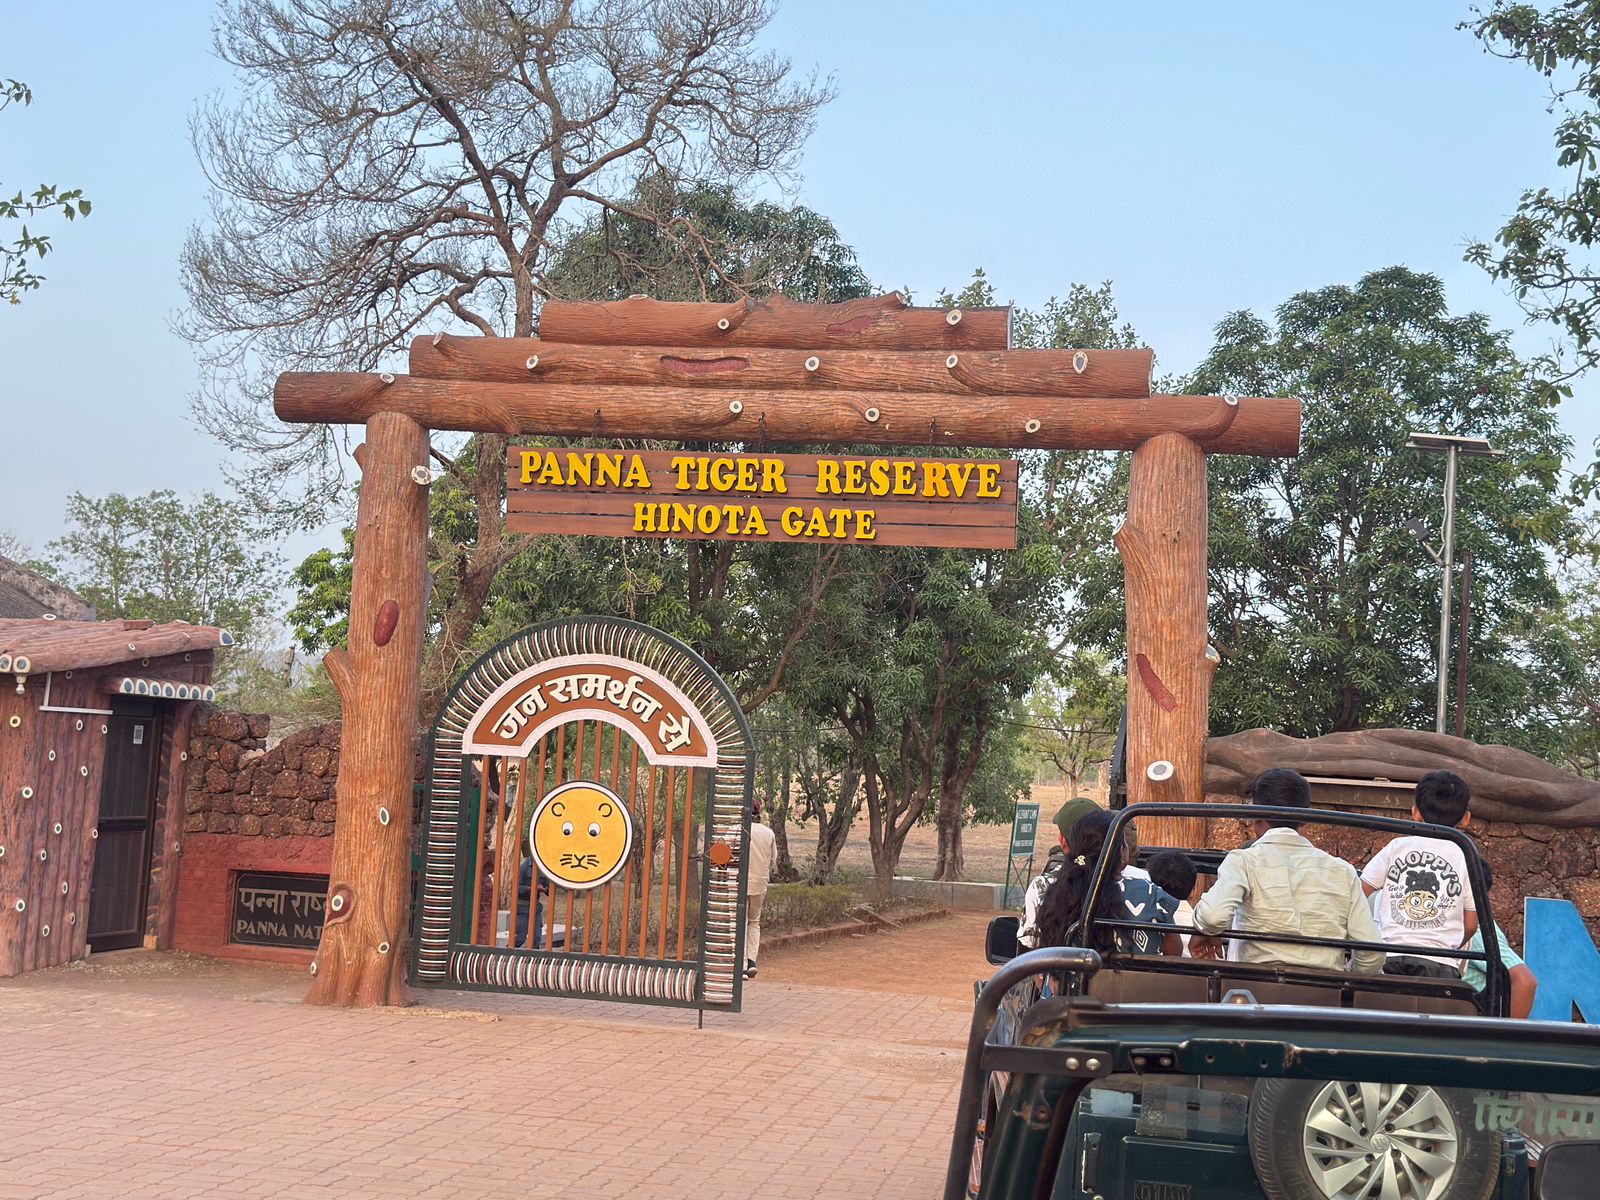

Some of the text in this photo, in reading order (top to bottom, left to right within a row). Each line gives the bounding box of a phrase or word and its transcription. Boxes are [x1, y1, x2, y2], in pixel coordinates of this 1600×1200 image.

[520, 451, 1001, 497] PANNA TIGER RESERVE
[633, 503, 876, 539] HINOTA GATE
[491, 673, 691, 752] जन समर्थन से
[239, 888, 327, 917] पन्ना राष्
[237, 920, 324, 940] PANNA NAT
